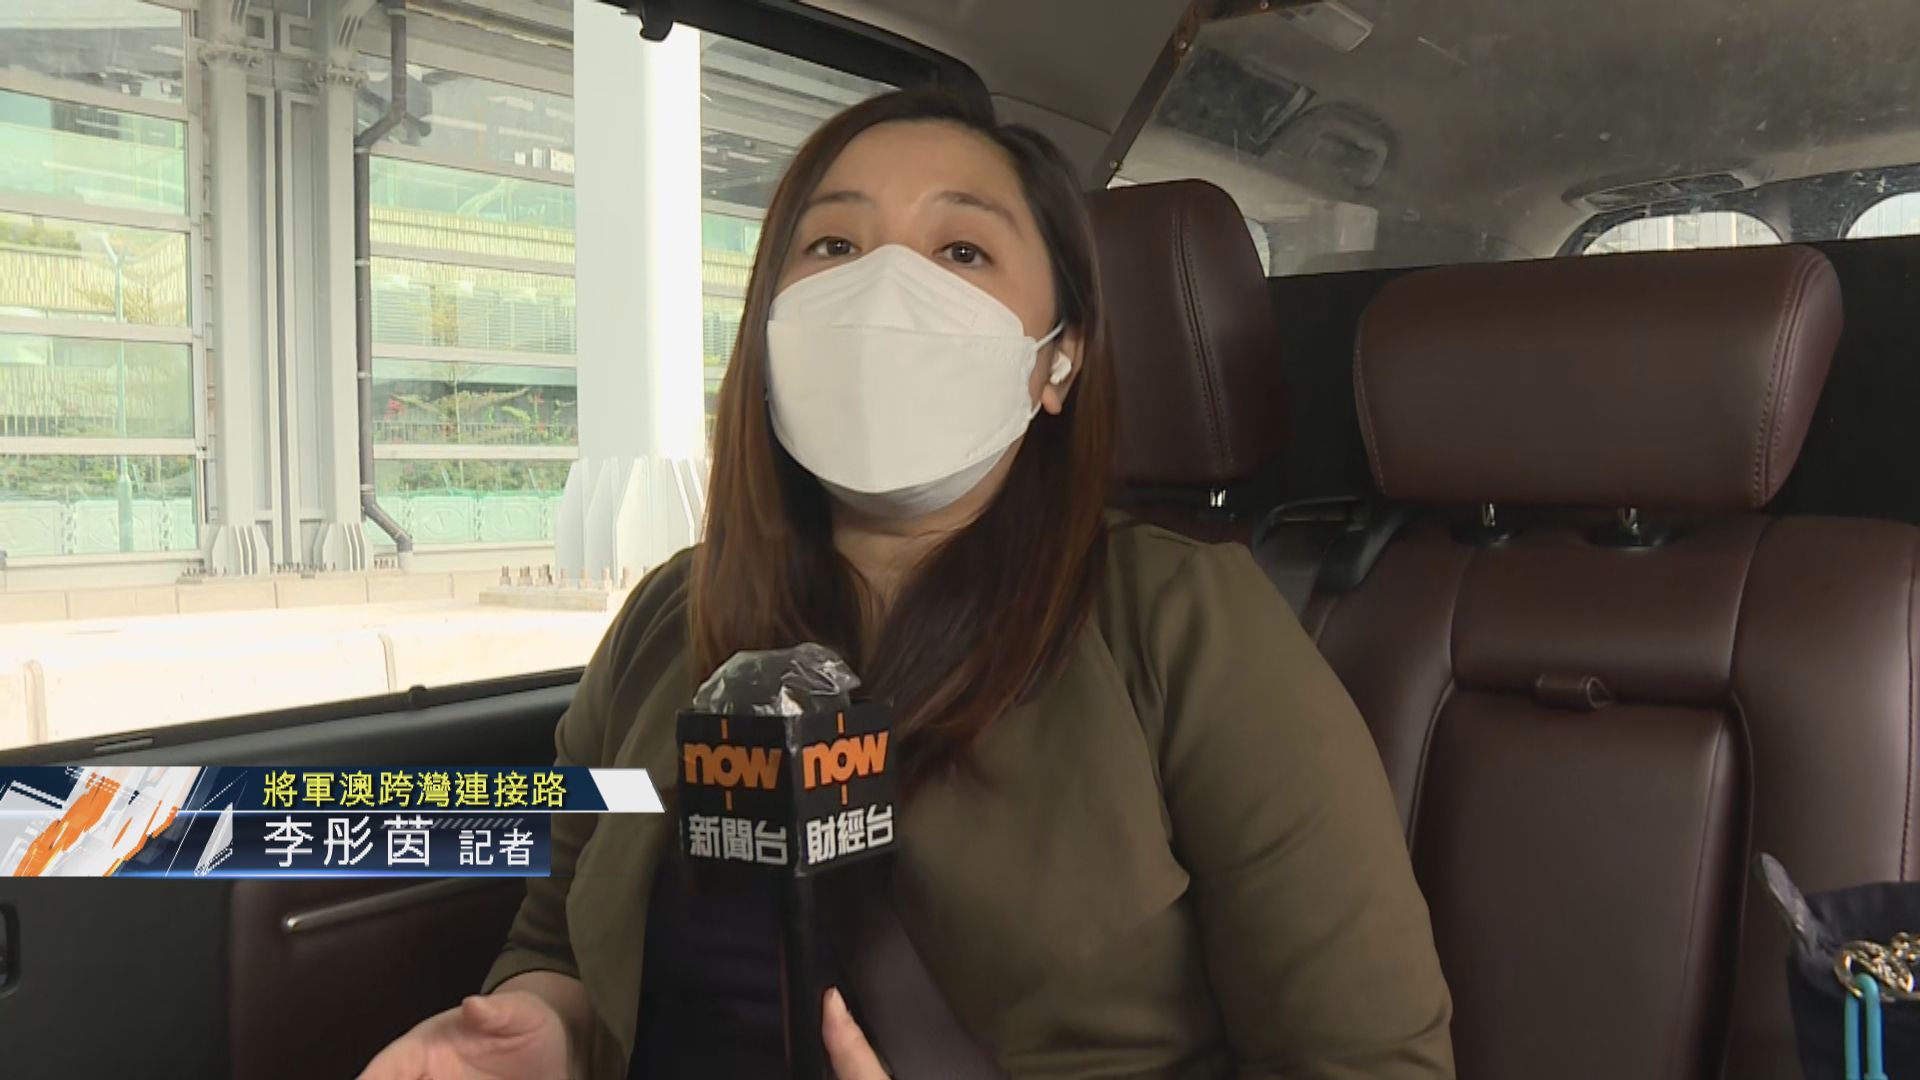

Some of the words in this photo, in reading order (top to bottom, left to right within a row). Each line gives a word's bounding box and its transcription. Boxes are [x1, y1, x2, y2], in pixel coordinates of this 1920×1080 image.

[683, 742, 782, 790] now
[802, 730, 888, 789] now
[688, 814, 788, 865] 新聞台
[806, 804, 893, 865] 財經台
